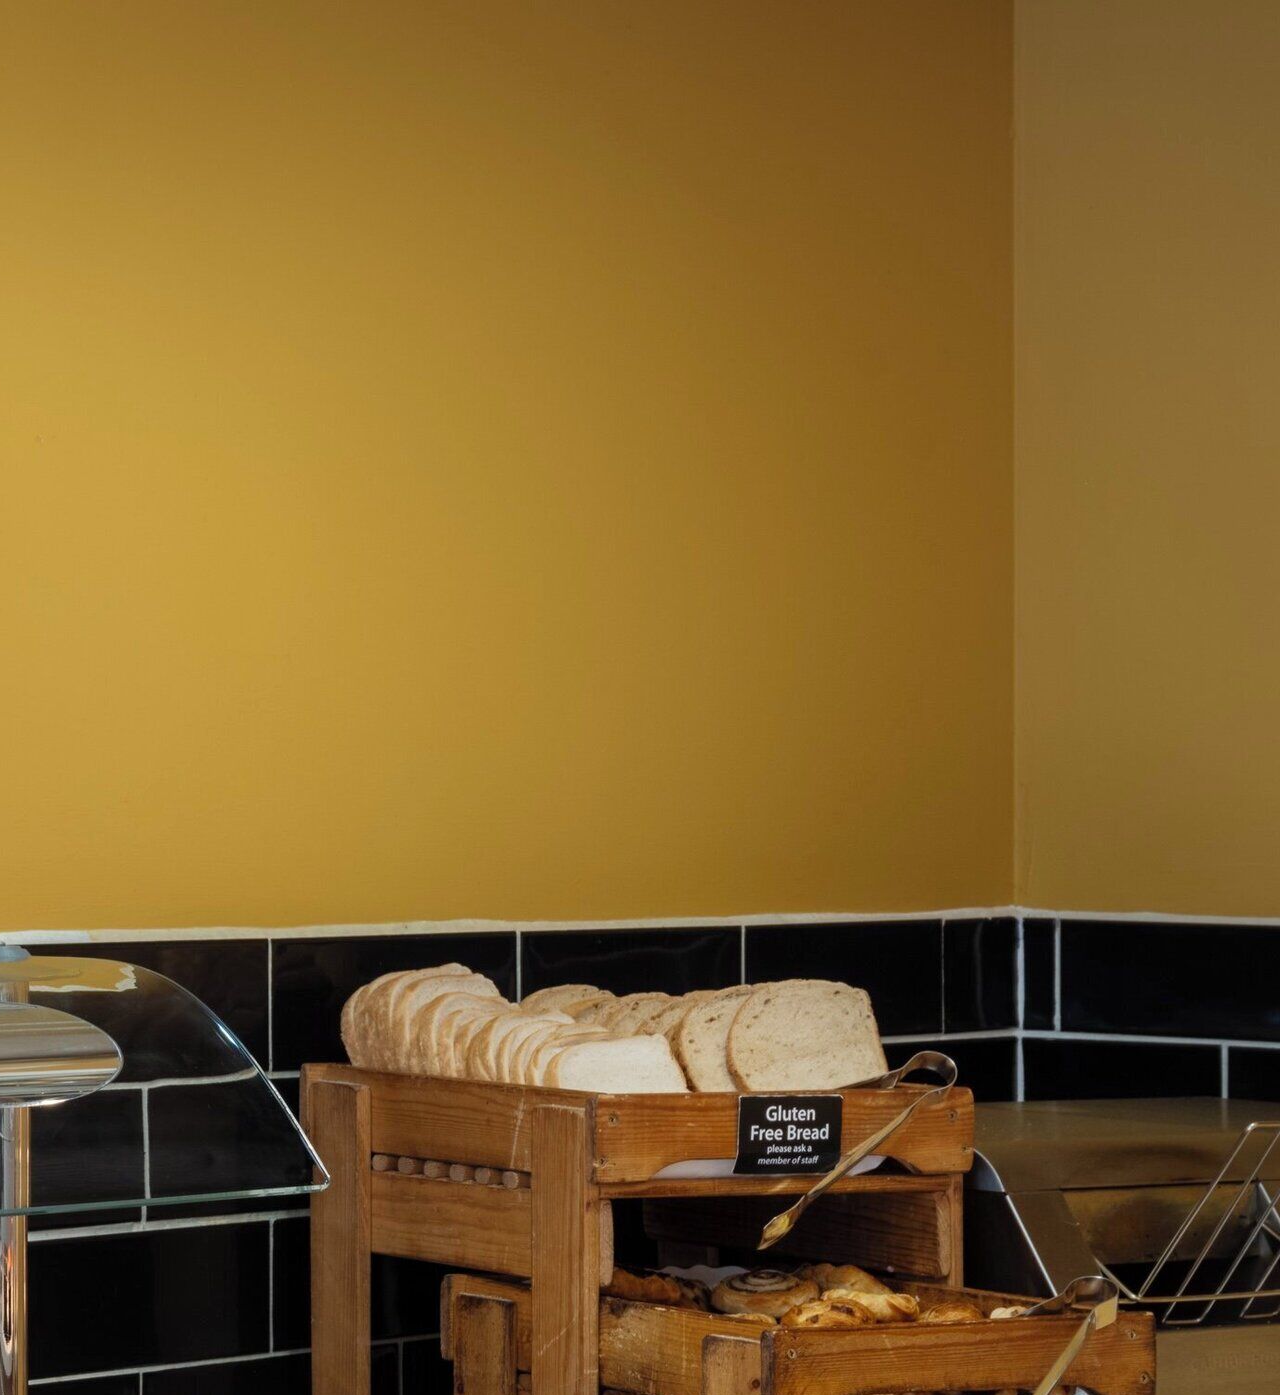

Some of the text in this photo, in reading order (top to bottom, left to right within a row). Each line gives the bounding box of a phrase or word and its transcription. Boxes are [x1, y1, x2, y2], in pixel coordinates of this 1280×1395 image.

[766, 1104, 816, 1121] Gluten
[750, 1123, 829, 1141] Free Bread
[766, 1143, 792, 1154] please
[793, 1143, 806, 1153] ask
[757, 1155, 819, 1165] member of staff
